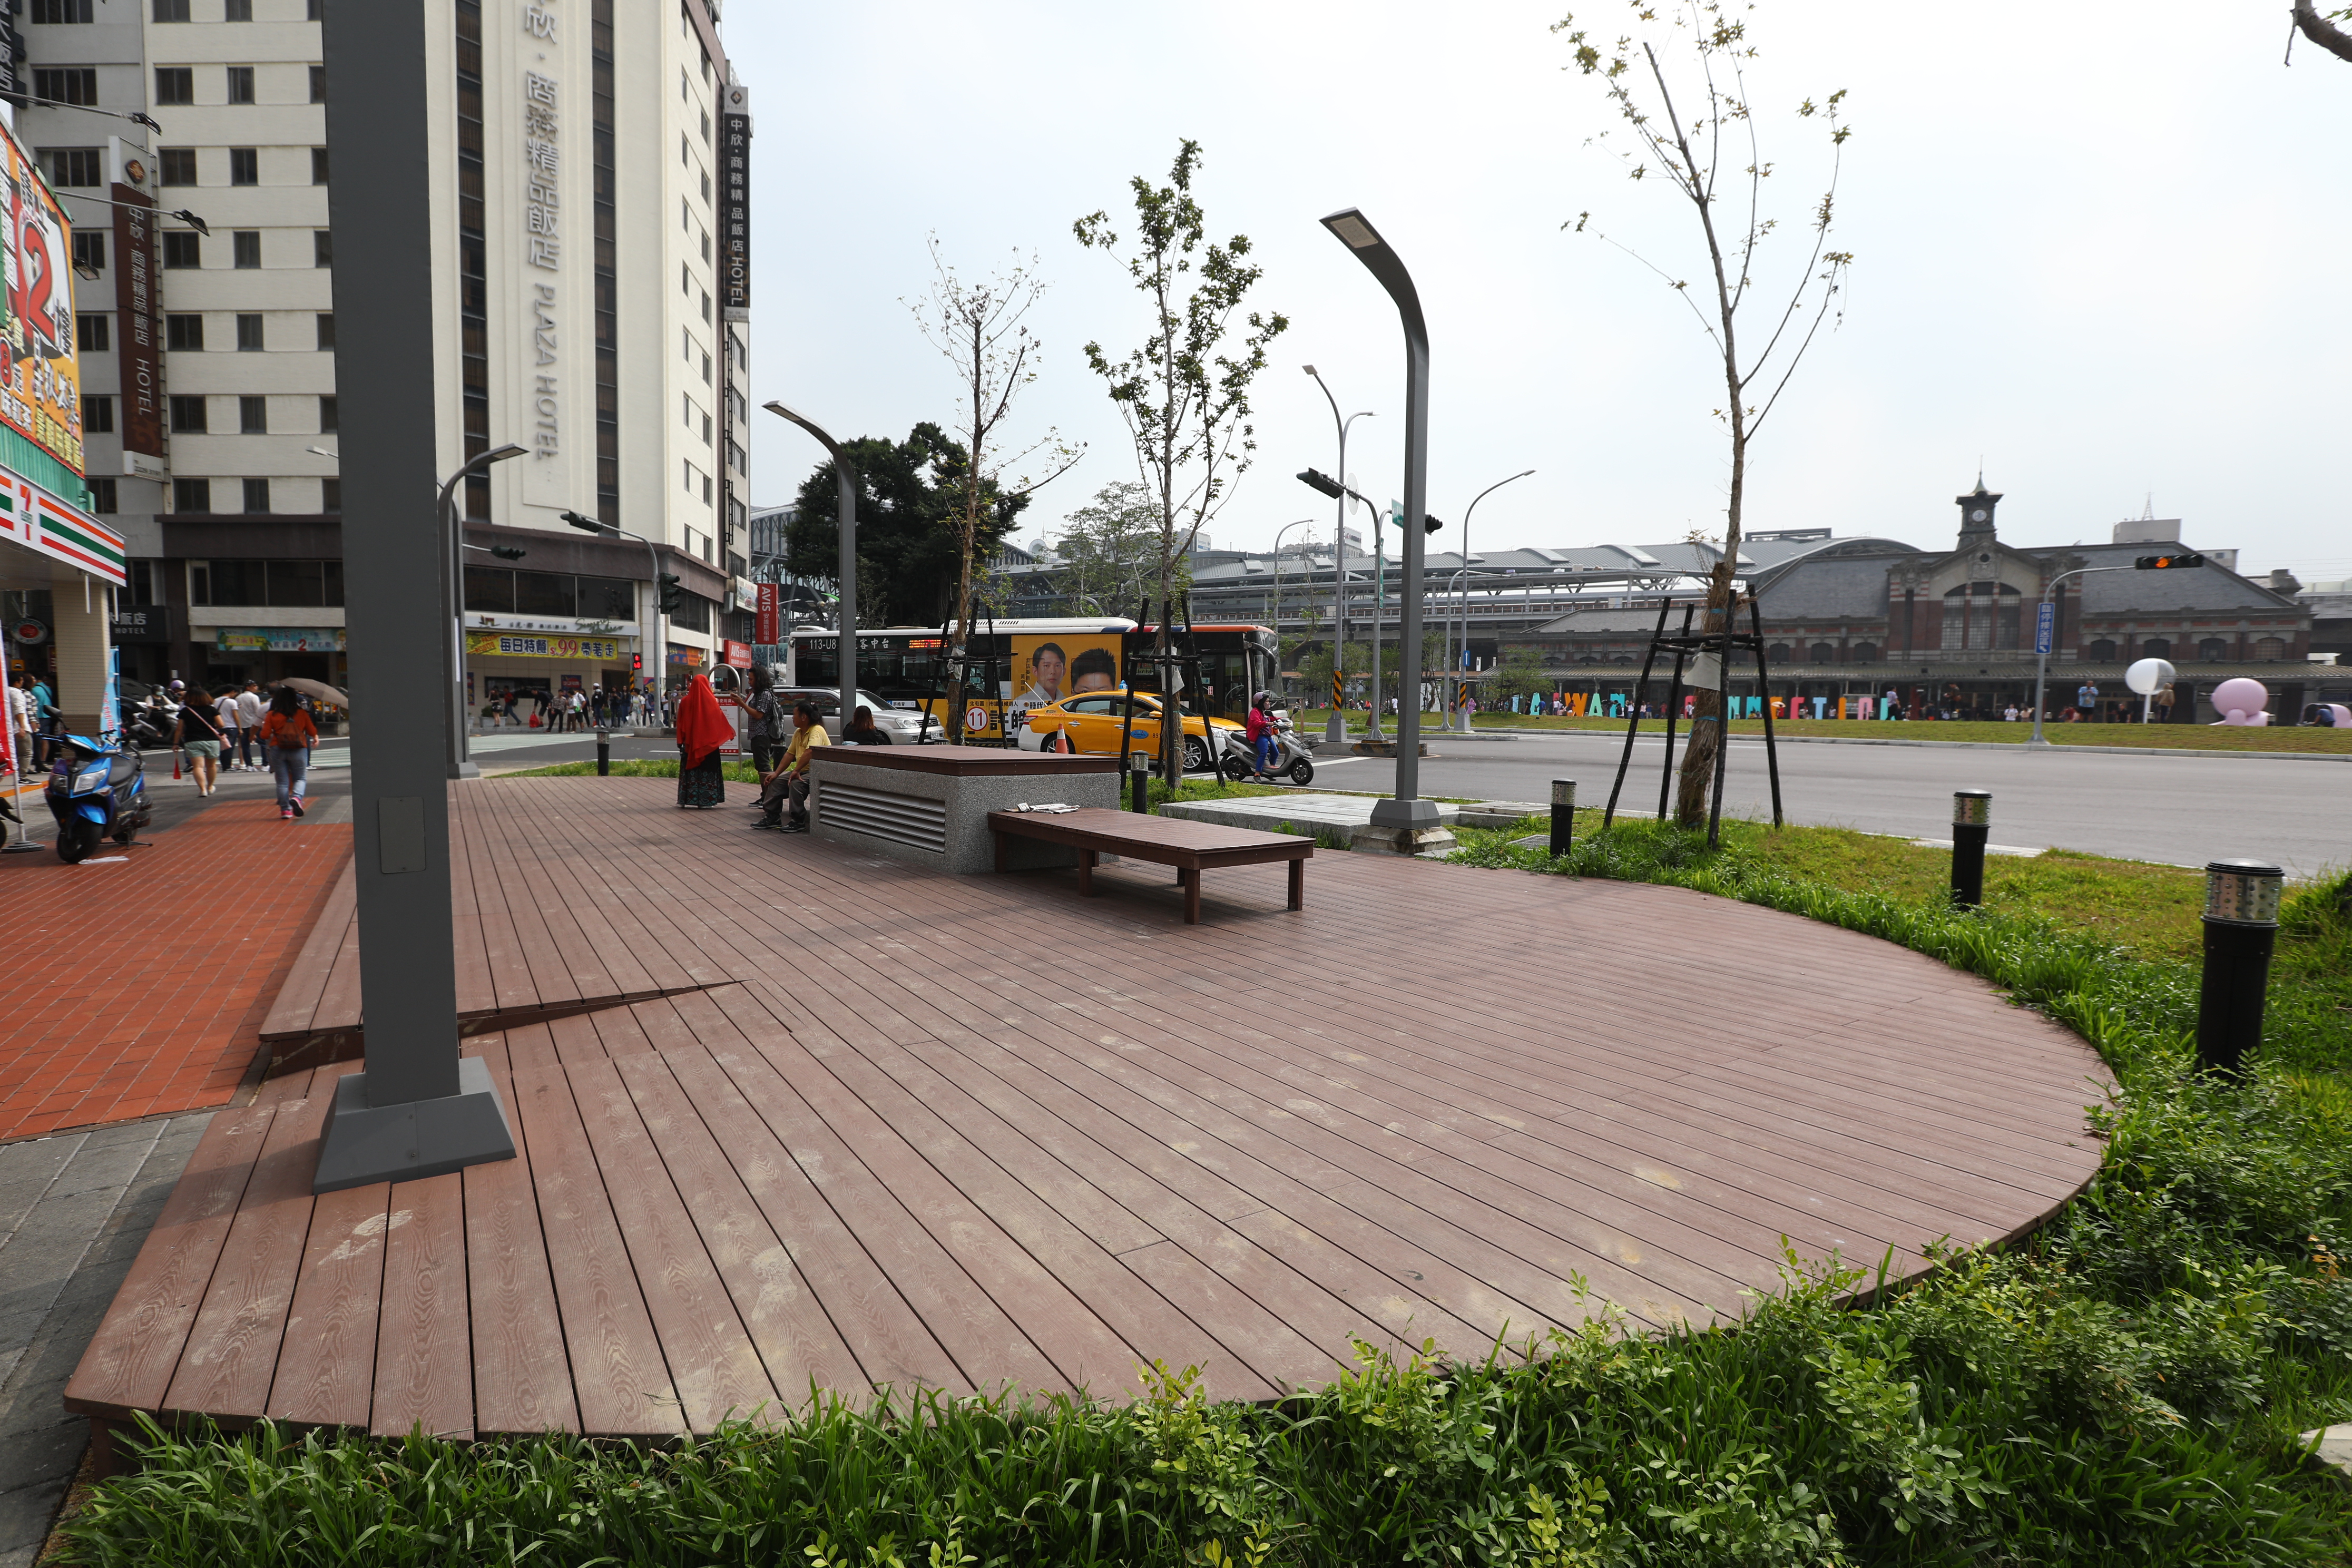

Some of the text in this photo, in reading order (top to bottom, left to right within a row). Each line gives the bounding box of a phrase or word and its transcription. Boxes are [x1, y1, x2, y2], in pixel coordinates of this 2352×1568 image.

[731, 257, 743, 305] HOTEL
[535, 282, 557, 367] PLAZA
[136, 358, 152, 415] HOTEL
[536, 375, 558, 460] HOTEL
[762, 586, 771, 611] AVIS
[500, 637, 548, 654] 每日特餐
[581, 641, 614, 657] 帶著走
[731, 644, 739, 658] AVIS
[810, 639, 837, 649] 113-U8
[969, 712, 983, 726] 11
